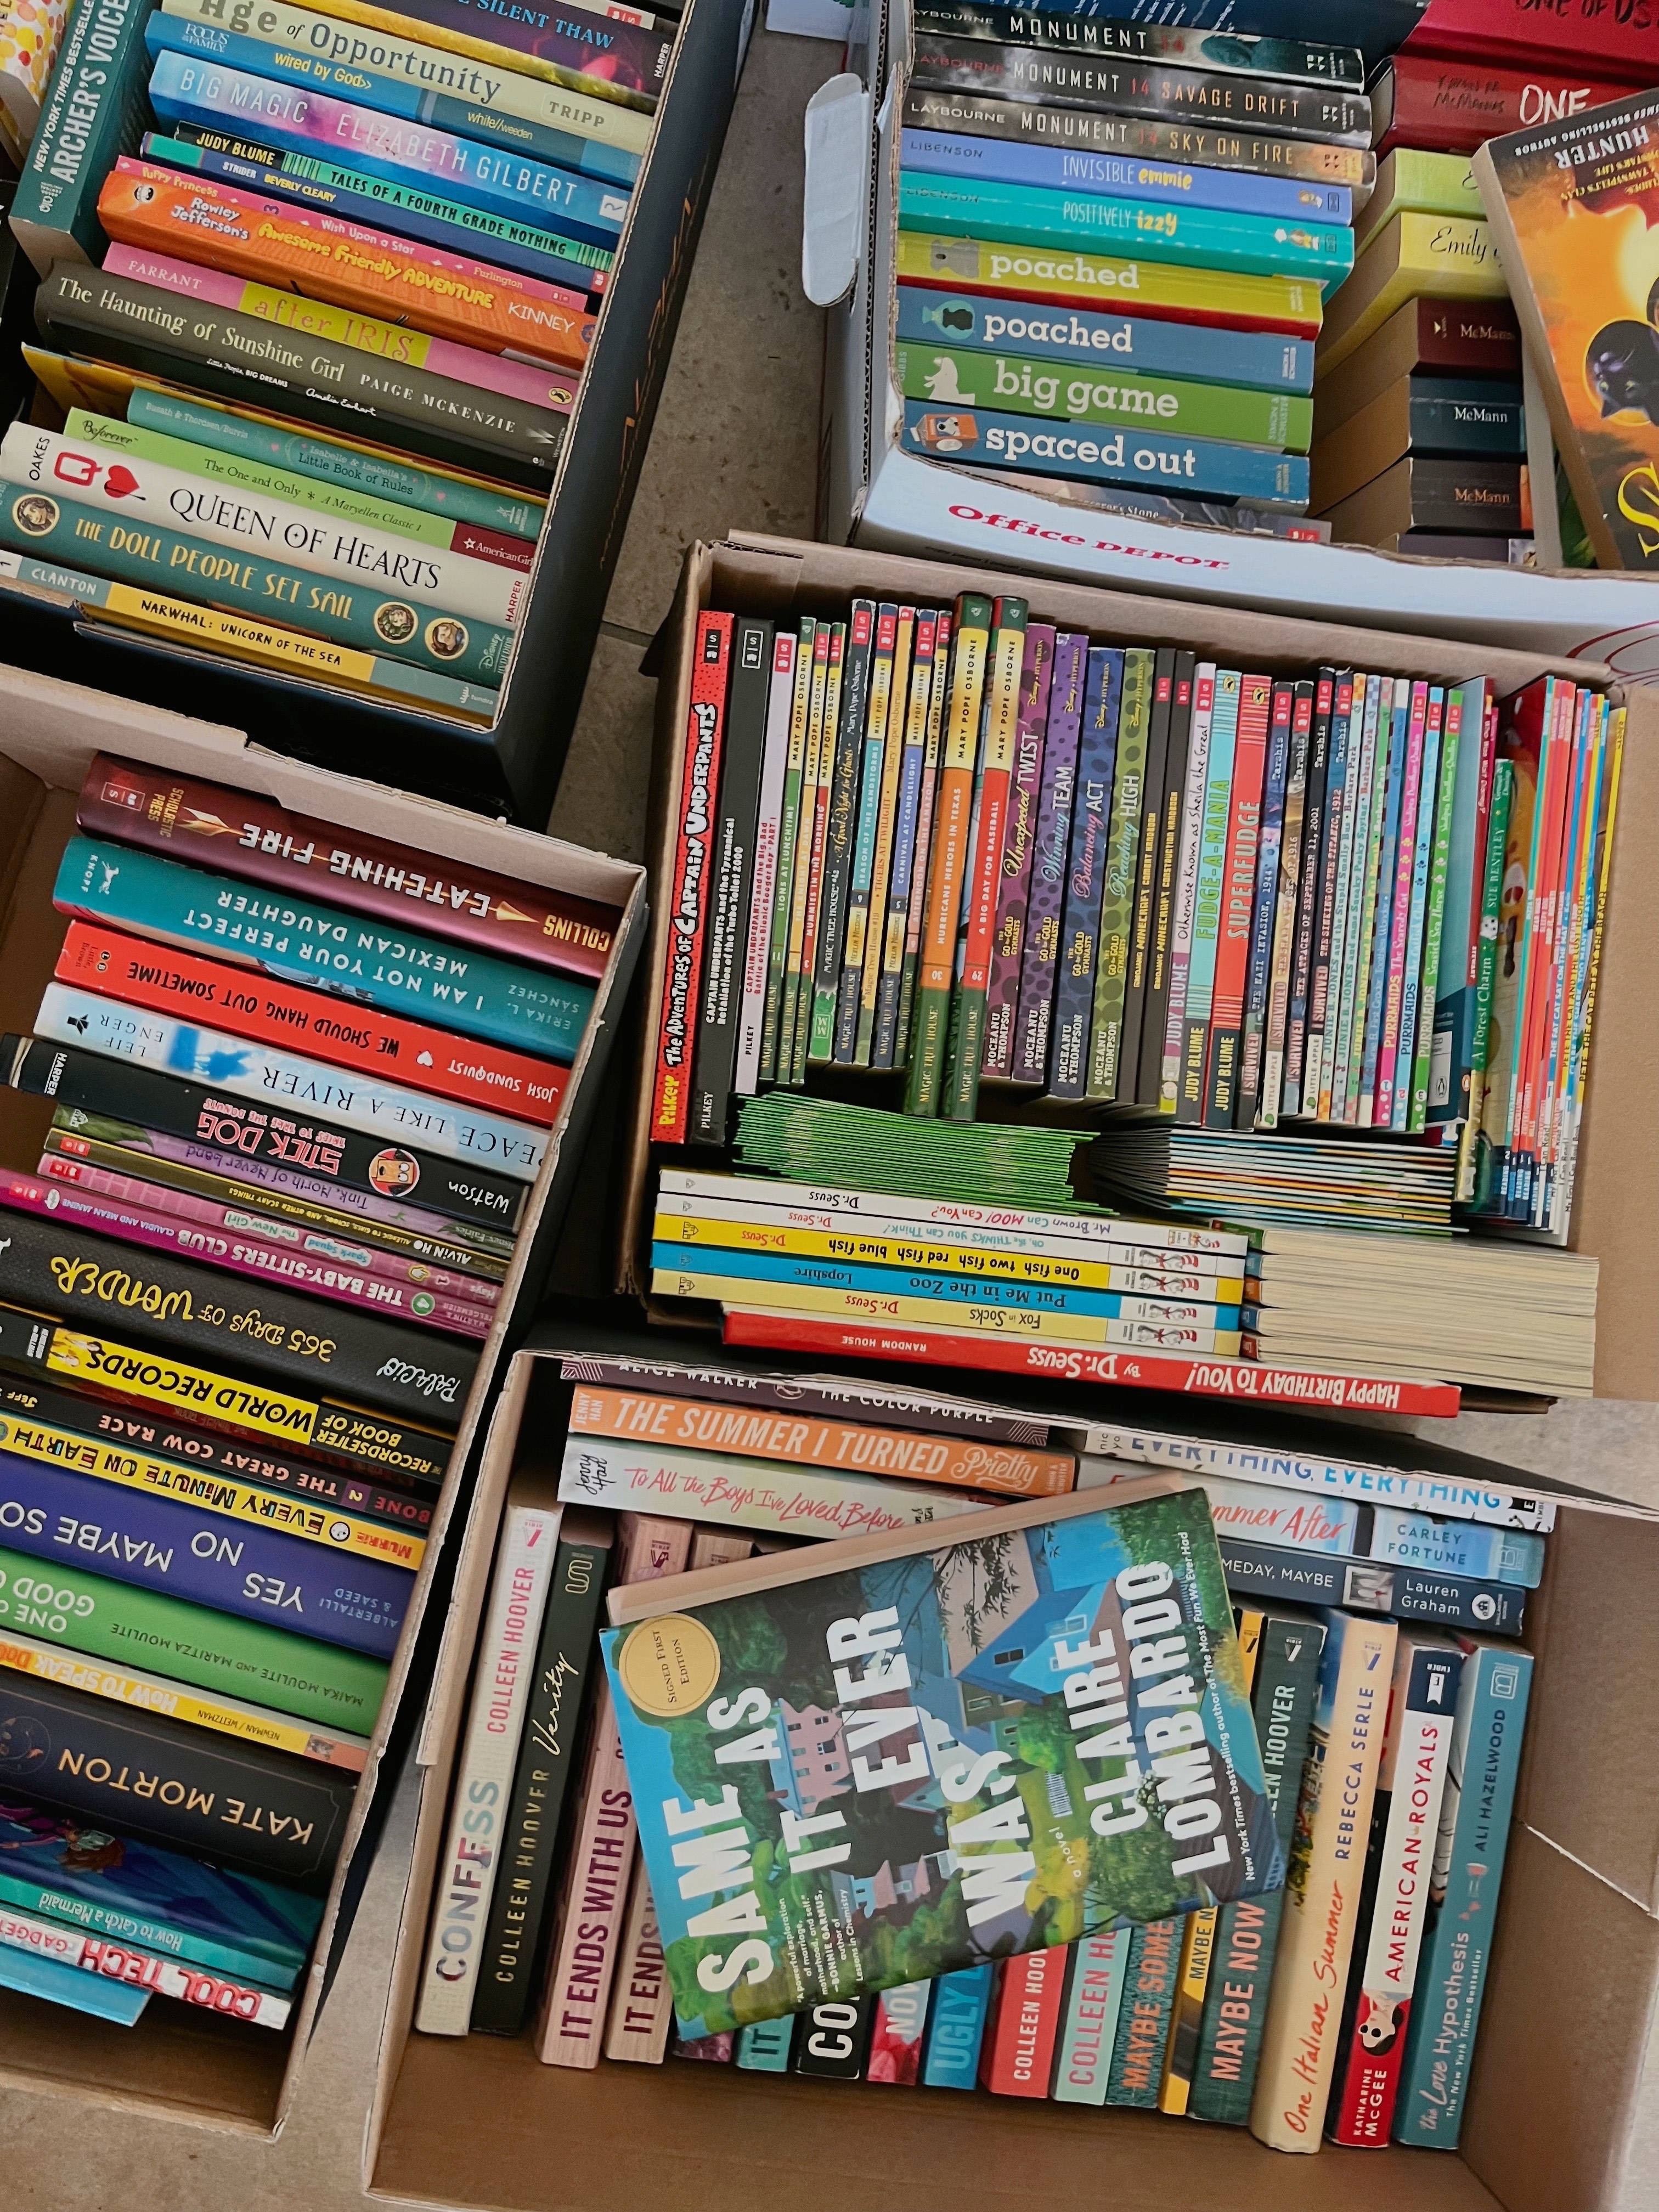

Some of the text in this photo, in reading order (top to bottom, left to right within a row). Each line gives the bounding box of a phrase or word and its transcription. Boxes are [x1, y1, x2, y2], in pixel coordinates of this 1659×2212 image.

[181, 70, 308, 123] BIG MAGIC
[286, 25, 306, 40] of
[310, 23, 501, 104] Opportunity
[1014, 61, 1120, 93] MONUMENT
[1162, 82, 1233, 108] SAVAGE
[1245, 93, 1300, 117] DRIFT
[550, 101, 605, 128] TRIPP
[1554, 125, 1650, 170] HUNTER
[195, 133, 275, 165] JUDY BLUME
[337, 114, 578, 206] ELIZABETH GILBERT
[1063, 156, 1193, 190] INVISIBLE emmie
[331, 172, 567, 255] TALES OF A FOURTH GRADE NOTHING
[59, 277, 345, 381] The Haunting of Sunshine Girl
[509, 302, 575, 334] KINNEY
[984, 313, 1134, 353] poached
[993, 359, 1180, 417] big game
[299, 452, 414, 495] Little Book of Rules
[986, 426, 1196, 478] spaced out
[1454, 489, 1510, 504] McMann
[75, 518, 352, 620] THE DOLL PEOPLE SET SAIL
[170, 488, 441, 589] QUEEN OF HEARTS
[948, 505, 1086, 546] Office
[1091, 540, 1232, 570] DEPOT
[141, 600, 341, 665] NARWHAL: UNICORN OF THE SEA
[505, 581, 523, 623] HARPER
[958, 726, 967, 759] MARY
[966, 640, 977, 690] OSBORNE
[1017, 732, 1039, 784] TWIST
[1052, 766, 1073, 811] TEAM
[1086, 780, 1104, 812] ACT
[1120, 775, 1139, 817] HIGH
[239, 823, 315, 865] FIRE
[1197, 780, 1230, 939] FUDGE-A-MANIA
[1227, 800, 1261, 939] SUPERFUDGE
[184, 909, 483, 1010] I AM NOT YOUR PERFECT
[217, 891, 468, 979] MEXICAN DAUGHTER
[543, 914, 611, 952] COLLINS
[127, 962, 399, 1057] WE SHOULD HANG OUT SOMETIME
[1384, 975, 1402, 1048] PURRMAIDS
[1058, 1024, 1071, 1083] MOCEANU
[1070, 1014, 1083, 1084] & THOMPSON
[1184, 1028, 1205, 1101] JUDY BLUME
[263, 1066, 543, 1166] EACE LIKE A RIVER
[701, 1092, 713, 1130] PILKEY
[828, 1239, 1080, 1280] One fish two fish red fish blue fish
[910, 1277, 1067, 1308] Put Me in the Zoo
[842, 1335, 927, 1352] RANDOM HOUSE
[87, 1353, 313, 1432] WORLD RECORDS
[1261, 1370, 1345, 1403] BIRTHDAY
[1346, 1381, 1400, 1410] HAPPY
[612, 1400, 675, 1434] THE
[678, 1412, 809, 1455] SUMMER
[812, 1427, 822, 1457] I
[831, 1431, 950, 1476] TURNED
[57, 1517, 304, 1612] YES NO MAYBE
[1387, 1544, 1468, 1565] FORTUNE
[1397, 1524, 1463, 1545] CARLEY
[1402, 1595, 1461, 1617] Graham
[1406, 1579, 1459, 1599] Lauren
[487, 1567, 536, 1734] COLLEEN HOOVER
[653, 1631, 677, 1703] SIGNED FIRST
[672, 1639, 690, 1685] EDITION
[532, 1652, 579, 1756] Verity
[1055, 1629, 1149, 1837] CLAIRE
[1115, 1561, 1230, 1877] LOMBARDO
[779, 1605, 930, 1874] IT EVER
[58, 1749, 314, 1845] KATE MORTON
[1474, 1709, 1505, 1852] ALI HAZELWOOD
[663, 1686, 782, 1995] SAME AS
[940, 1750, 1036, 1927] WAS
[1385, 1725, 1438, 1982] AMERICAN ROYALS
[560, 1790, 632, 2039] IT ENDS WITH US
[1210, 1901, 1268, 2081] MAYBE NOW
[1284, 1879, 1346, 2134] One Italian Summer
